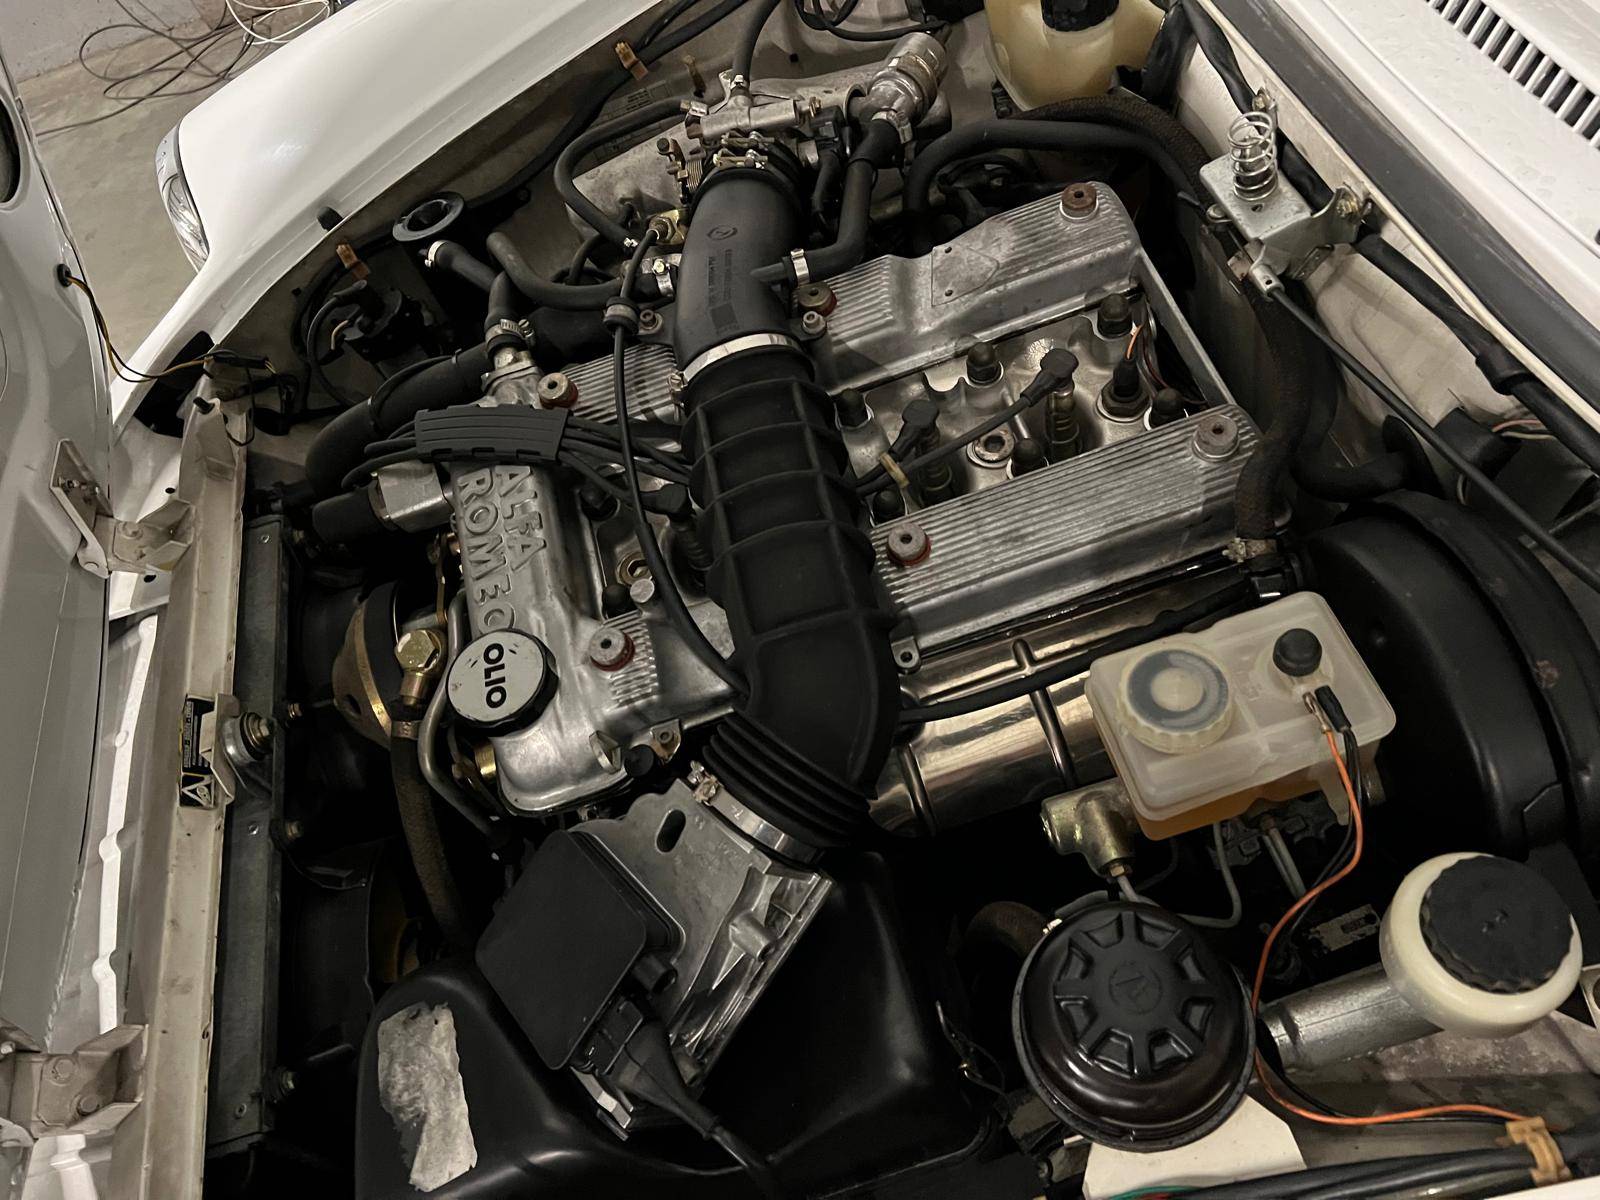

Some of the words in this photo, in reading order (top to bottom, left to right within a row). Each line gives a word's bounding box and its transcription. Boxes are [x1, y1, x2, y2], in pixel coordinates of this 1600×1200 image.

[457, 468, 516, 634] ROMEO
[495, 465, 547, 573] ALFA
[483, 642, 507, 709] OLIO
